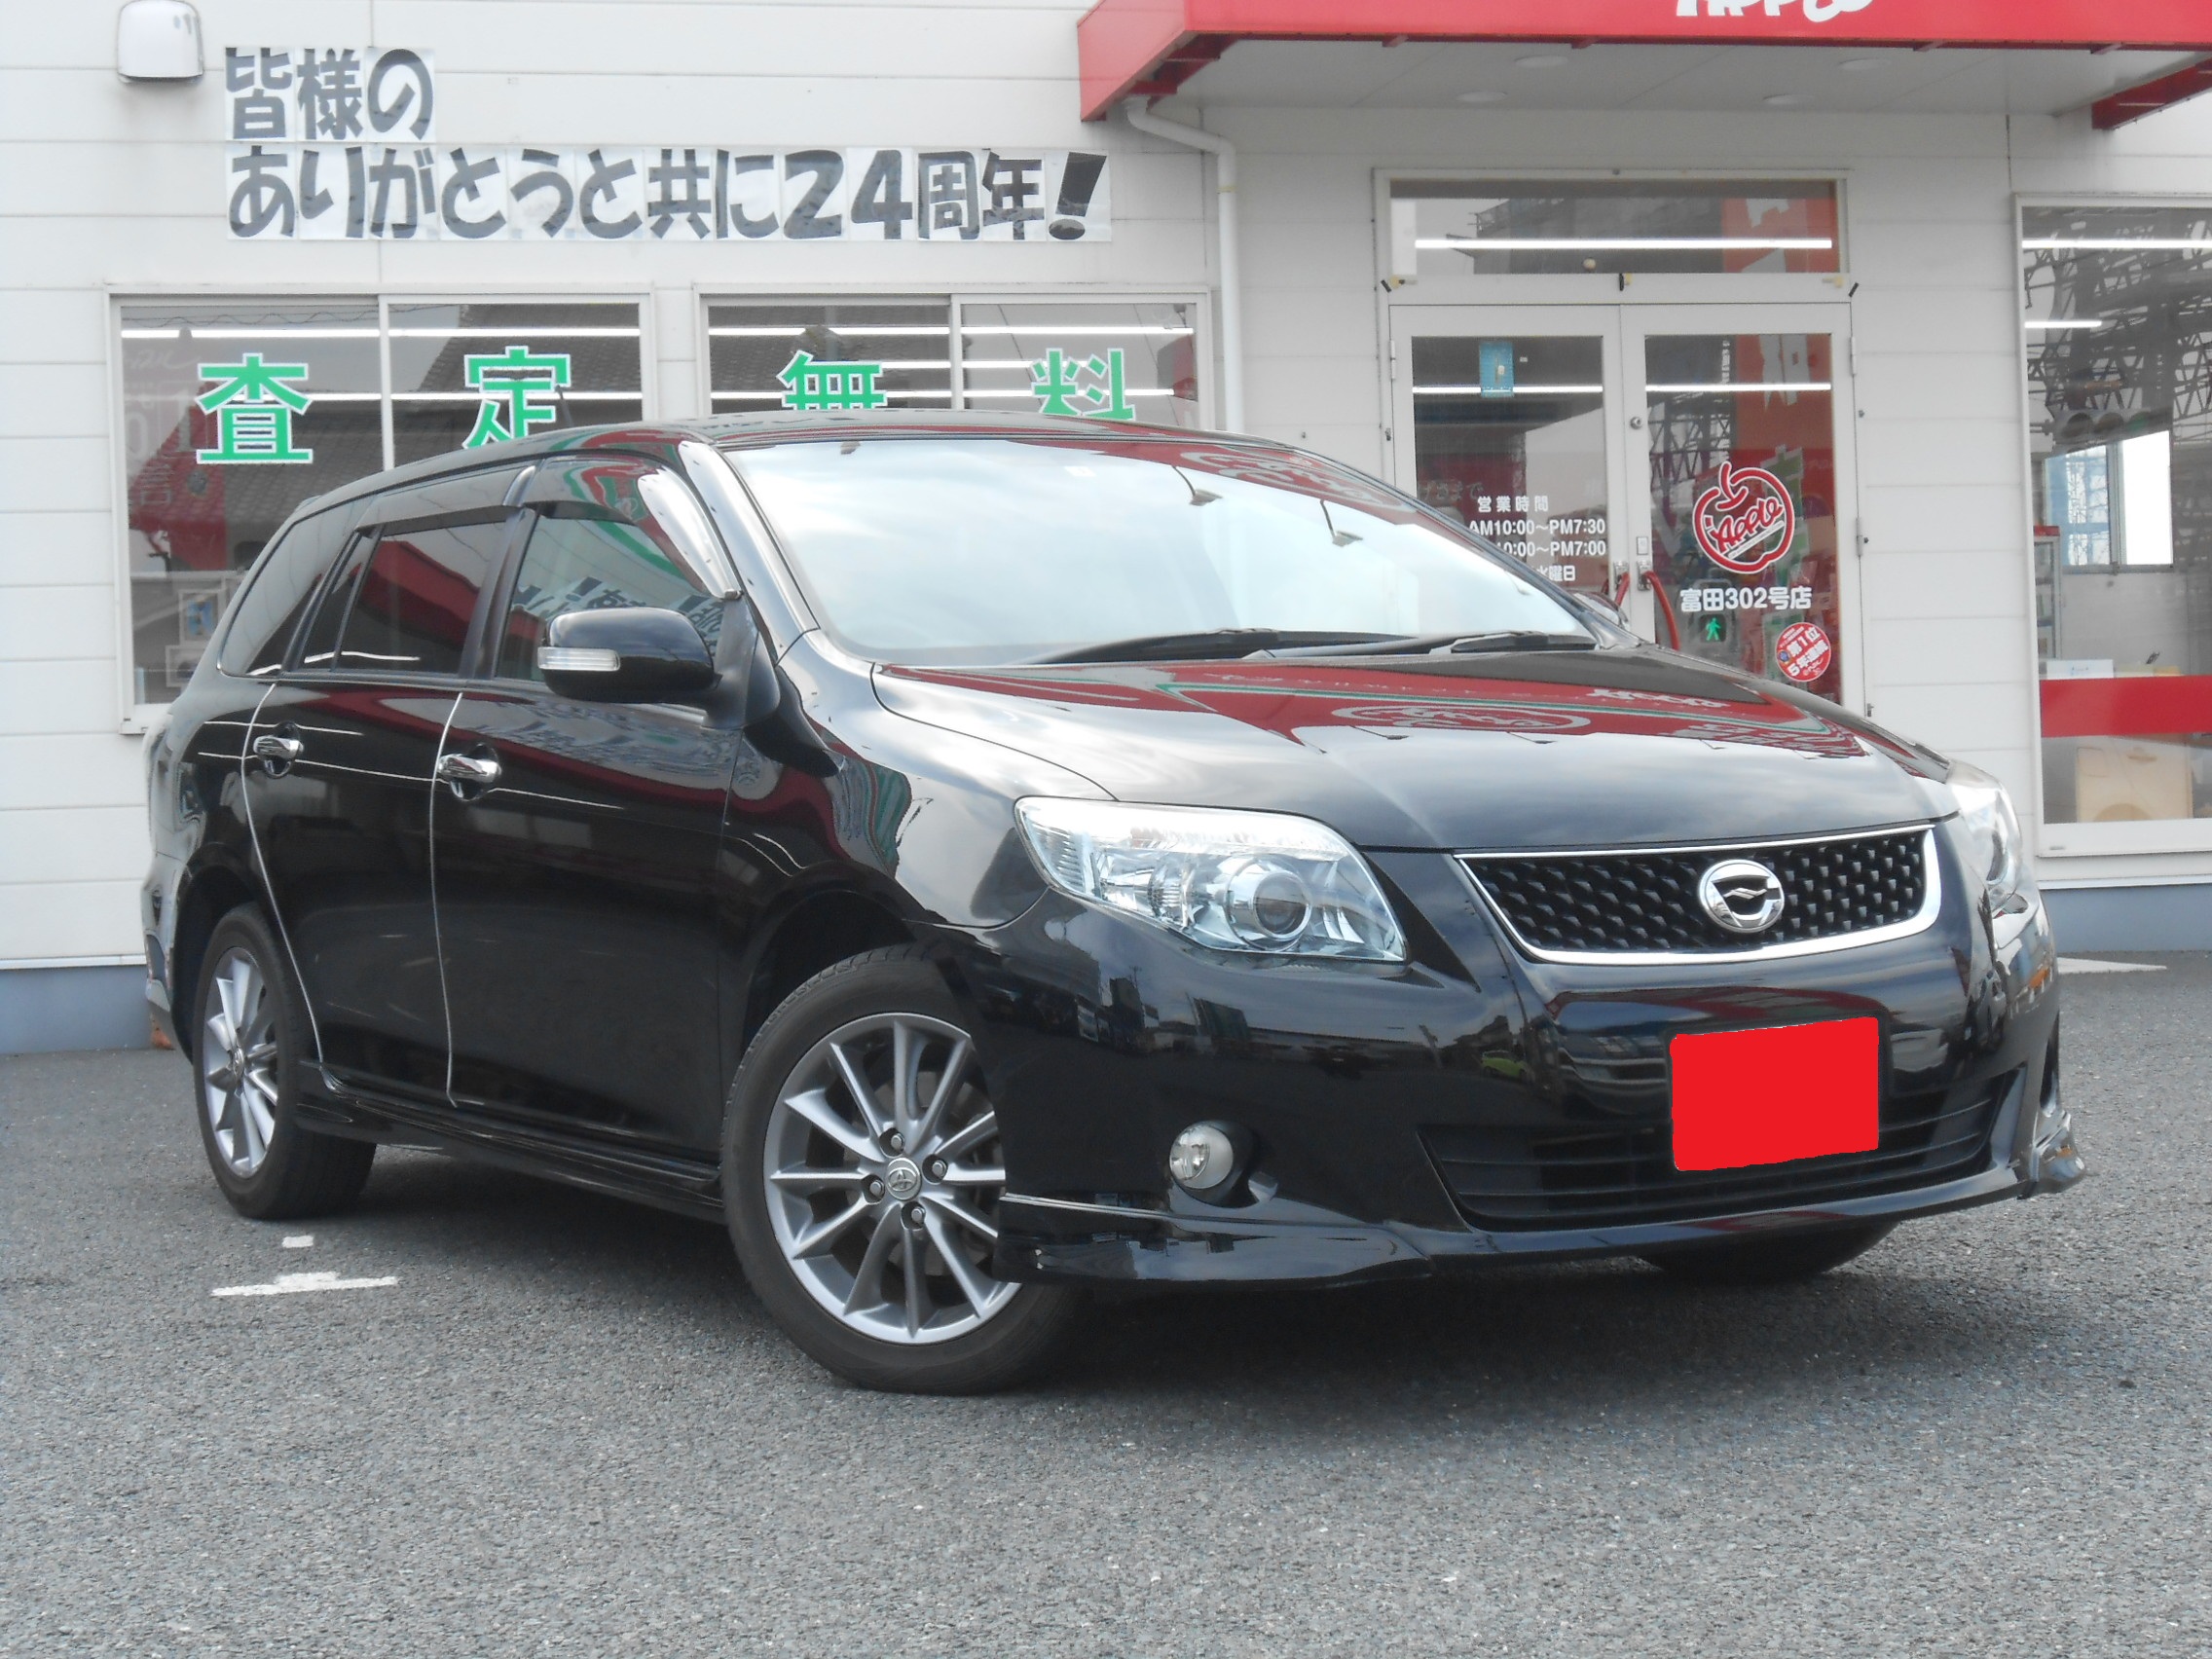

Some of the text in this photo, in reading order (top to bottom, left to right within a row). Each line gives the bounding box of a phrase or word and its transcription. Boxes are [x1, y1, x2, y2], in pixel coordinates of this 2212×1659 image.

[225, 47, 433, 140] 皆様の
[1477, 496, 1549, 512] 営業時間
[1679, 586, 1813, 612] 富田302号店
